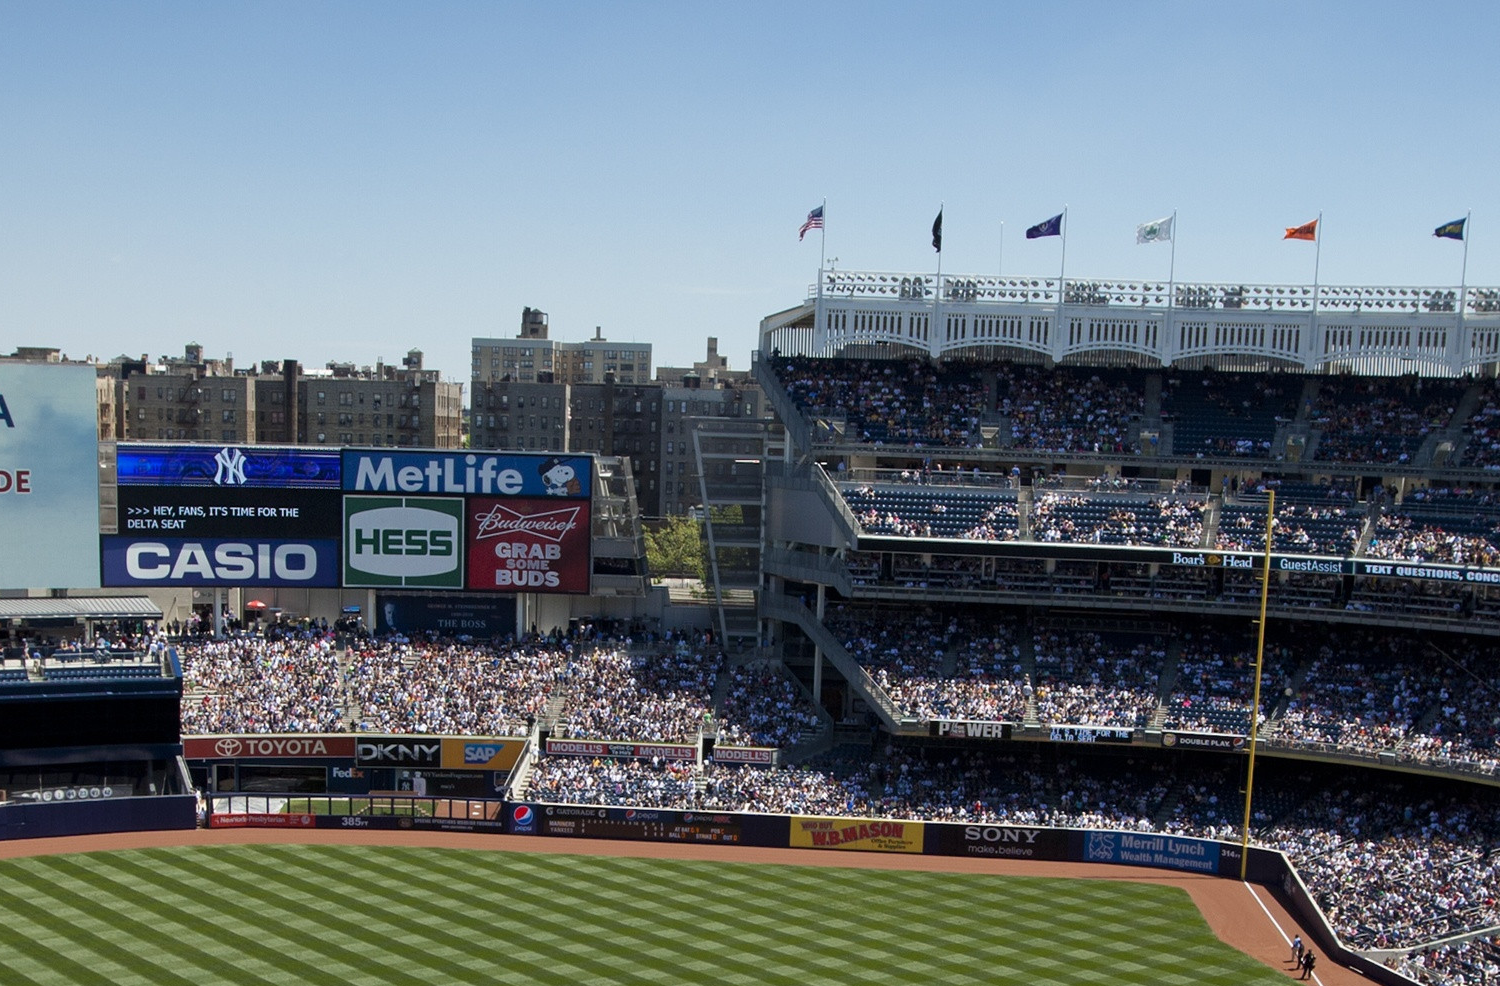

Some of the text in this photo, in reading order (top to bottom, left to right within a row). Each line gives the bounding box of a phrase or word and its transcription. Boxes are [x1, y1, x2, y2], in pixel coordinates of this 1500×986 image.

[354, 454, 524, 495] MetLife
[153, 506, 176, 517] HEY,
[179, 506, 206, 517] FANS,
[209, 506, 228, 516] IT'S
[230, 506, 255, 517] TIME
[257, 507, 277, 517] FOR
[279, 507, 299, 518] THE
[127, 519, 186, 529] DELTA SEAT
[475, 512, 577, 532] Budweiser
[354, 528, 452, 557] HESS
[495, 541, 561, 560] GRAB
[126, 542, 318, 580] CASIO
[506, 558, 550, 570] SOME
[1172, 552, 1253, 568] Boar's Head
[1280, 558, 1343, 573] GuestAssist
[495, 569, 561, 588] BUDS
[1365, 564, 1393, 575] TEXT
[1396, 566, 1463, 581] QUESTIONS,
[437, 619, 487, 629] THE BOSS
[245, 738, 328, 756] TOYOTA
[551, 742, 603, 754] MODELL'S
[1179, 737, 1209, 746] DOUBLE
[357, 742, 441, 762] DKNY
[464, 745, 496, 761] SAP
[638, 746, 692, 758] MODELL'S
[716, 750, 769, 761] MODELL'S
[332, 767, 364, 779] FedEx
[556, 808, 595, 816] GATORADE
[964, 826, 1041, 844] SONY
[1120, 835, 1205, 856] Merrill Lynch
[1120, 851, 1213, 870] Wealth Management
